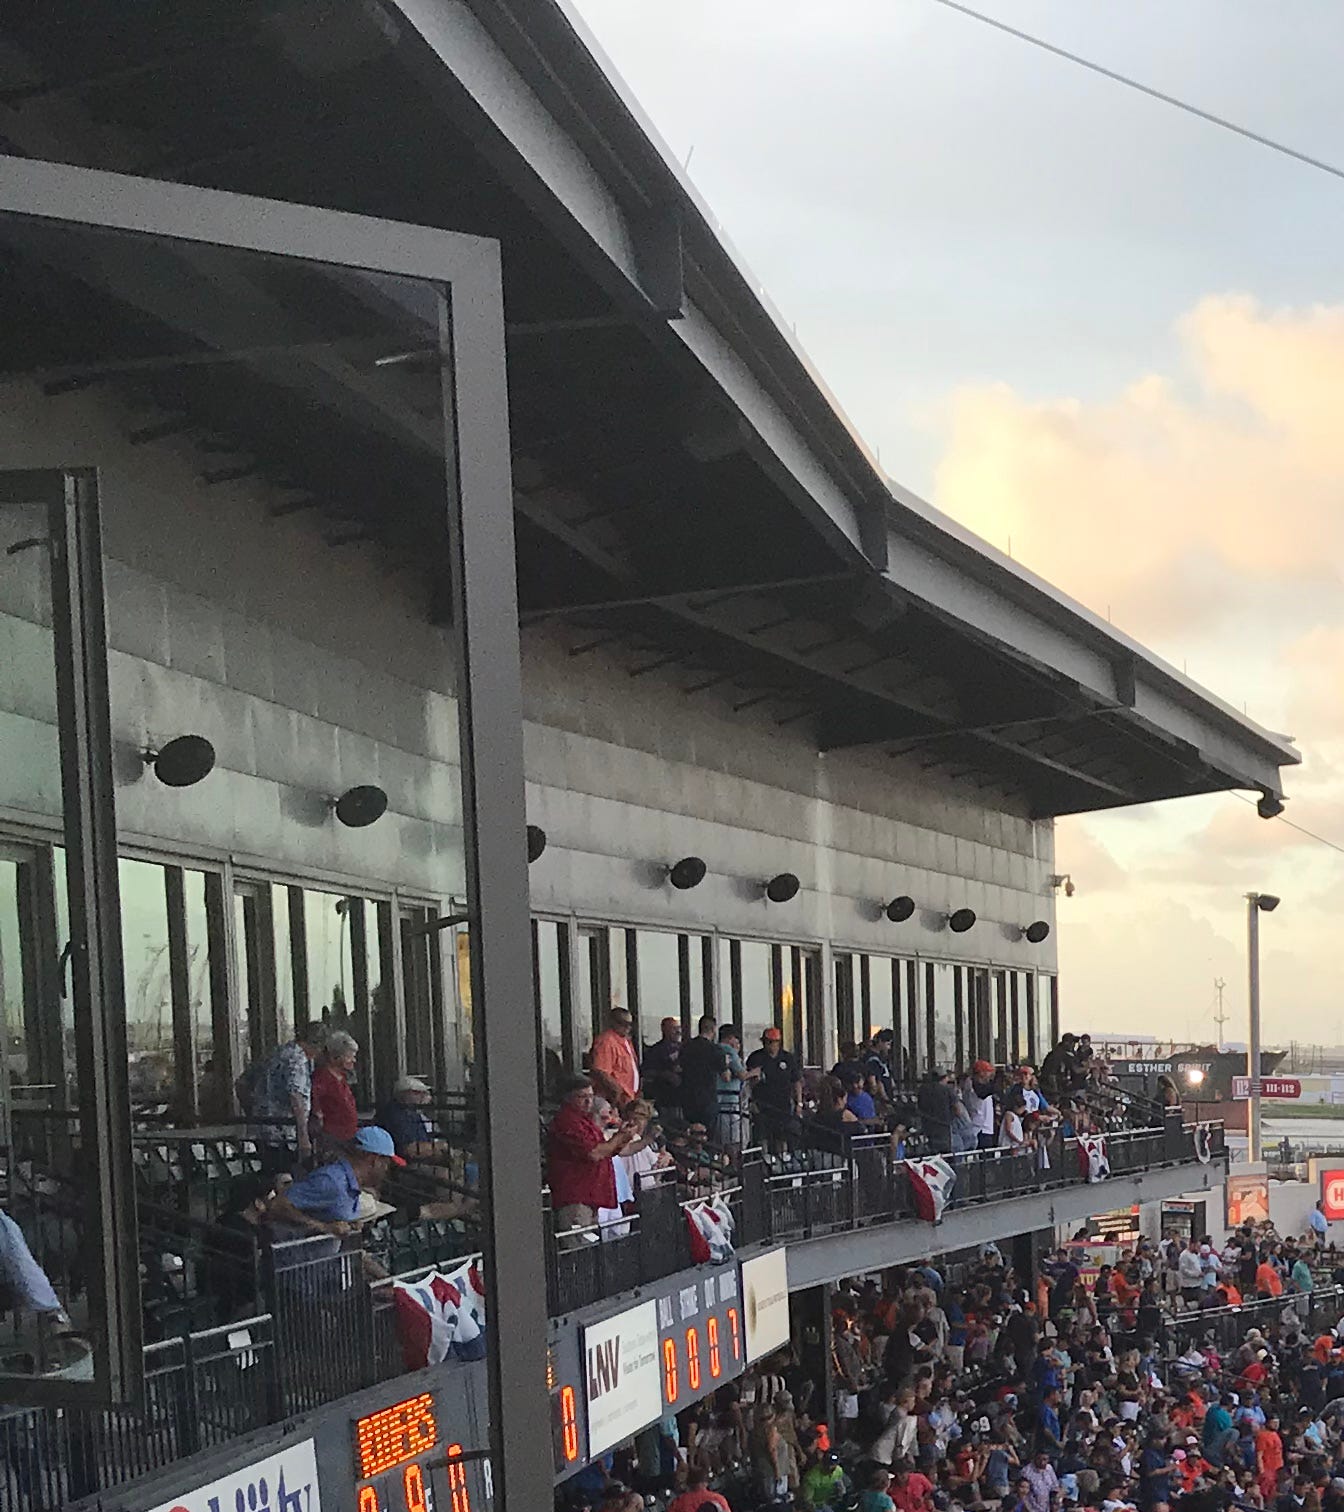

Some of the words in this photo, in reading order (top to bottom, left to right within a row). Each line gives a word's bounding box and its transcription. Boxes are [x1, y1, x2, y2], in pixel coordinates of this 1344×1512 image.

[1128, 1063, 1172, 1073] ESTHER
[588, 1335, 620, 1401] LNV
[663, 1339, 678, 1403] 0
[686, 1328, 700, 1390] 0
[707, 1317, 721, 1377] 0
[727, 1308, 739, 1360] 7
[561, 1386, 577, 1462] 0
